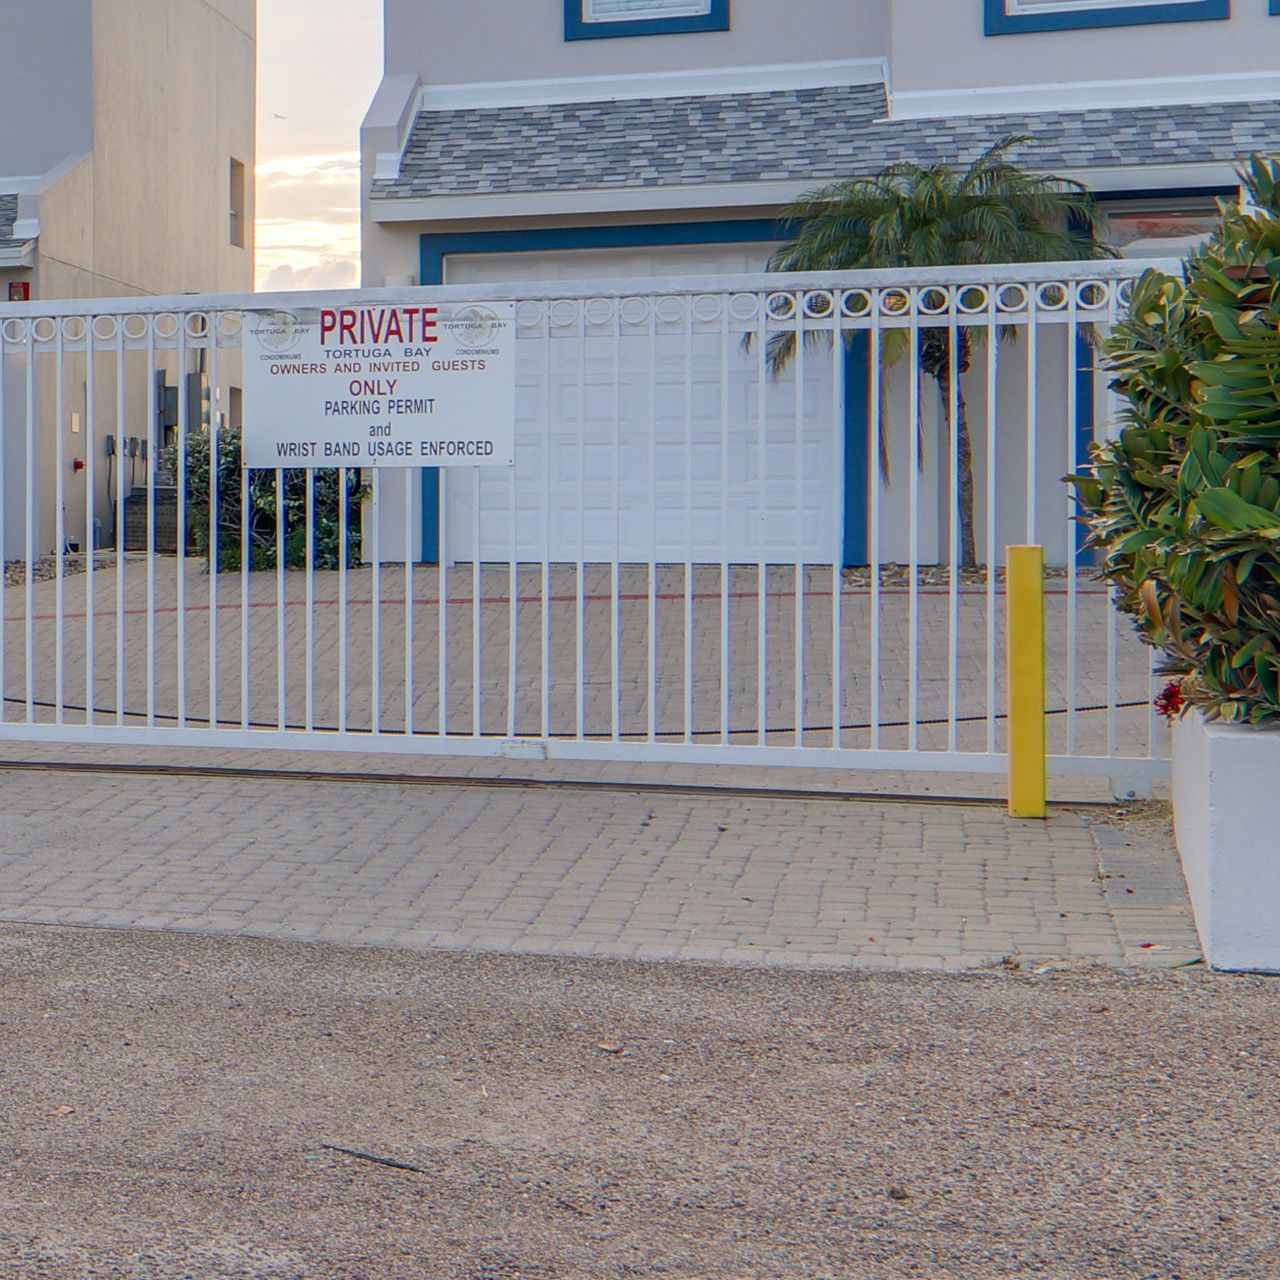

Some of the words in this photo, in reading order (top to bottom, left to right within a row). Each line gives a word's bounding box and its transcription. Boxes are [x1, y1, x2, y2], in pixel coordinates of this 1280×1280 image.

[320, 307, 438, 345] PRIVATE
[324, 348, 392, 359] TORTUGA
[404, 348, 432, 357] BAY
[270, 363, 327, 375] OWNERS
[334, 362, 362, 373] AND
[369, 361, 420, 372] INVITED
[432, 360, 486, 371] GUESTS
[350, 380, 397, 396] ONLY
[324, 400, 380, 416] PARKING
[388, 398, 435, 414] PERMIT
[369, 422, 391, 437] and
[276, 442, 316, 457] WRIST
[324, 442, 360, 456] BAND
[368, 442, 412, 456] USAGE
[421, 440, 493, 456] ENFORCED
